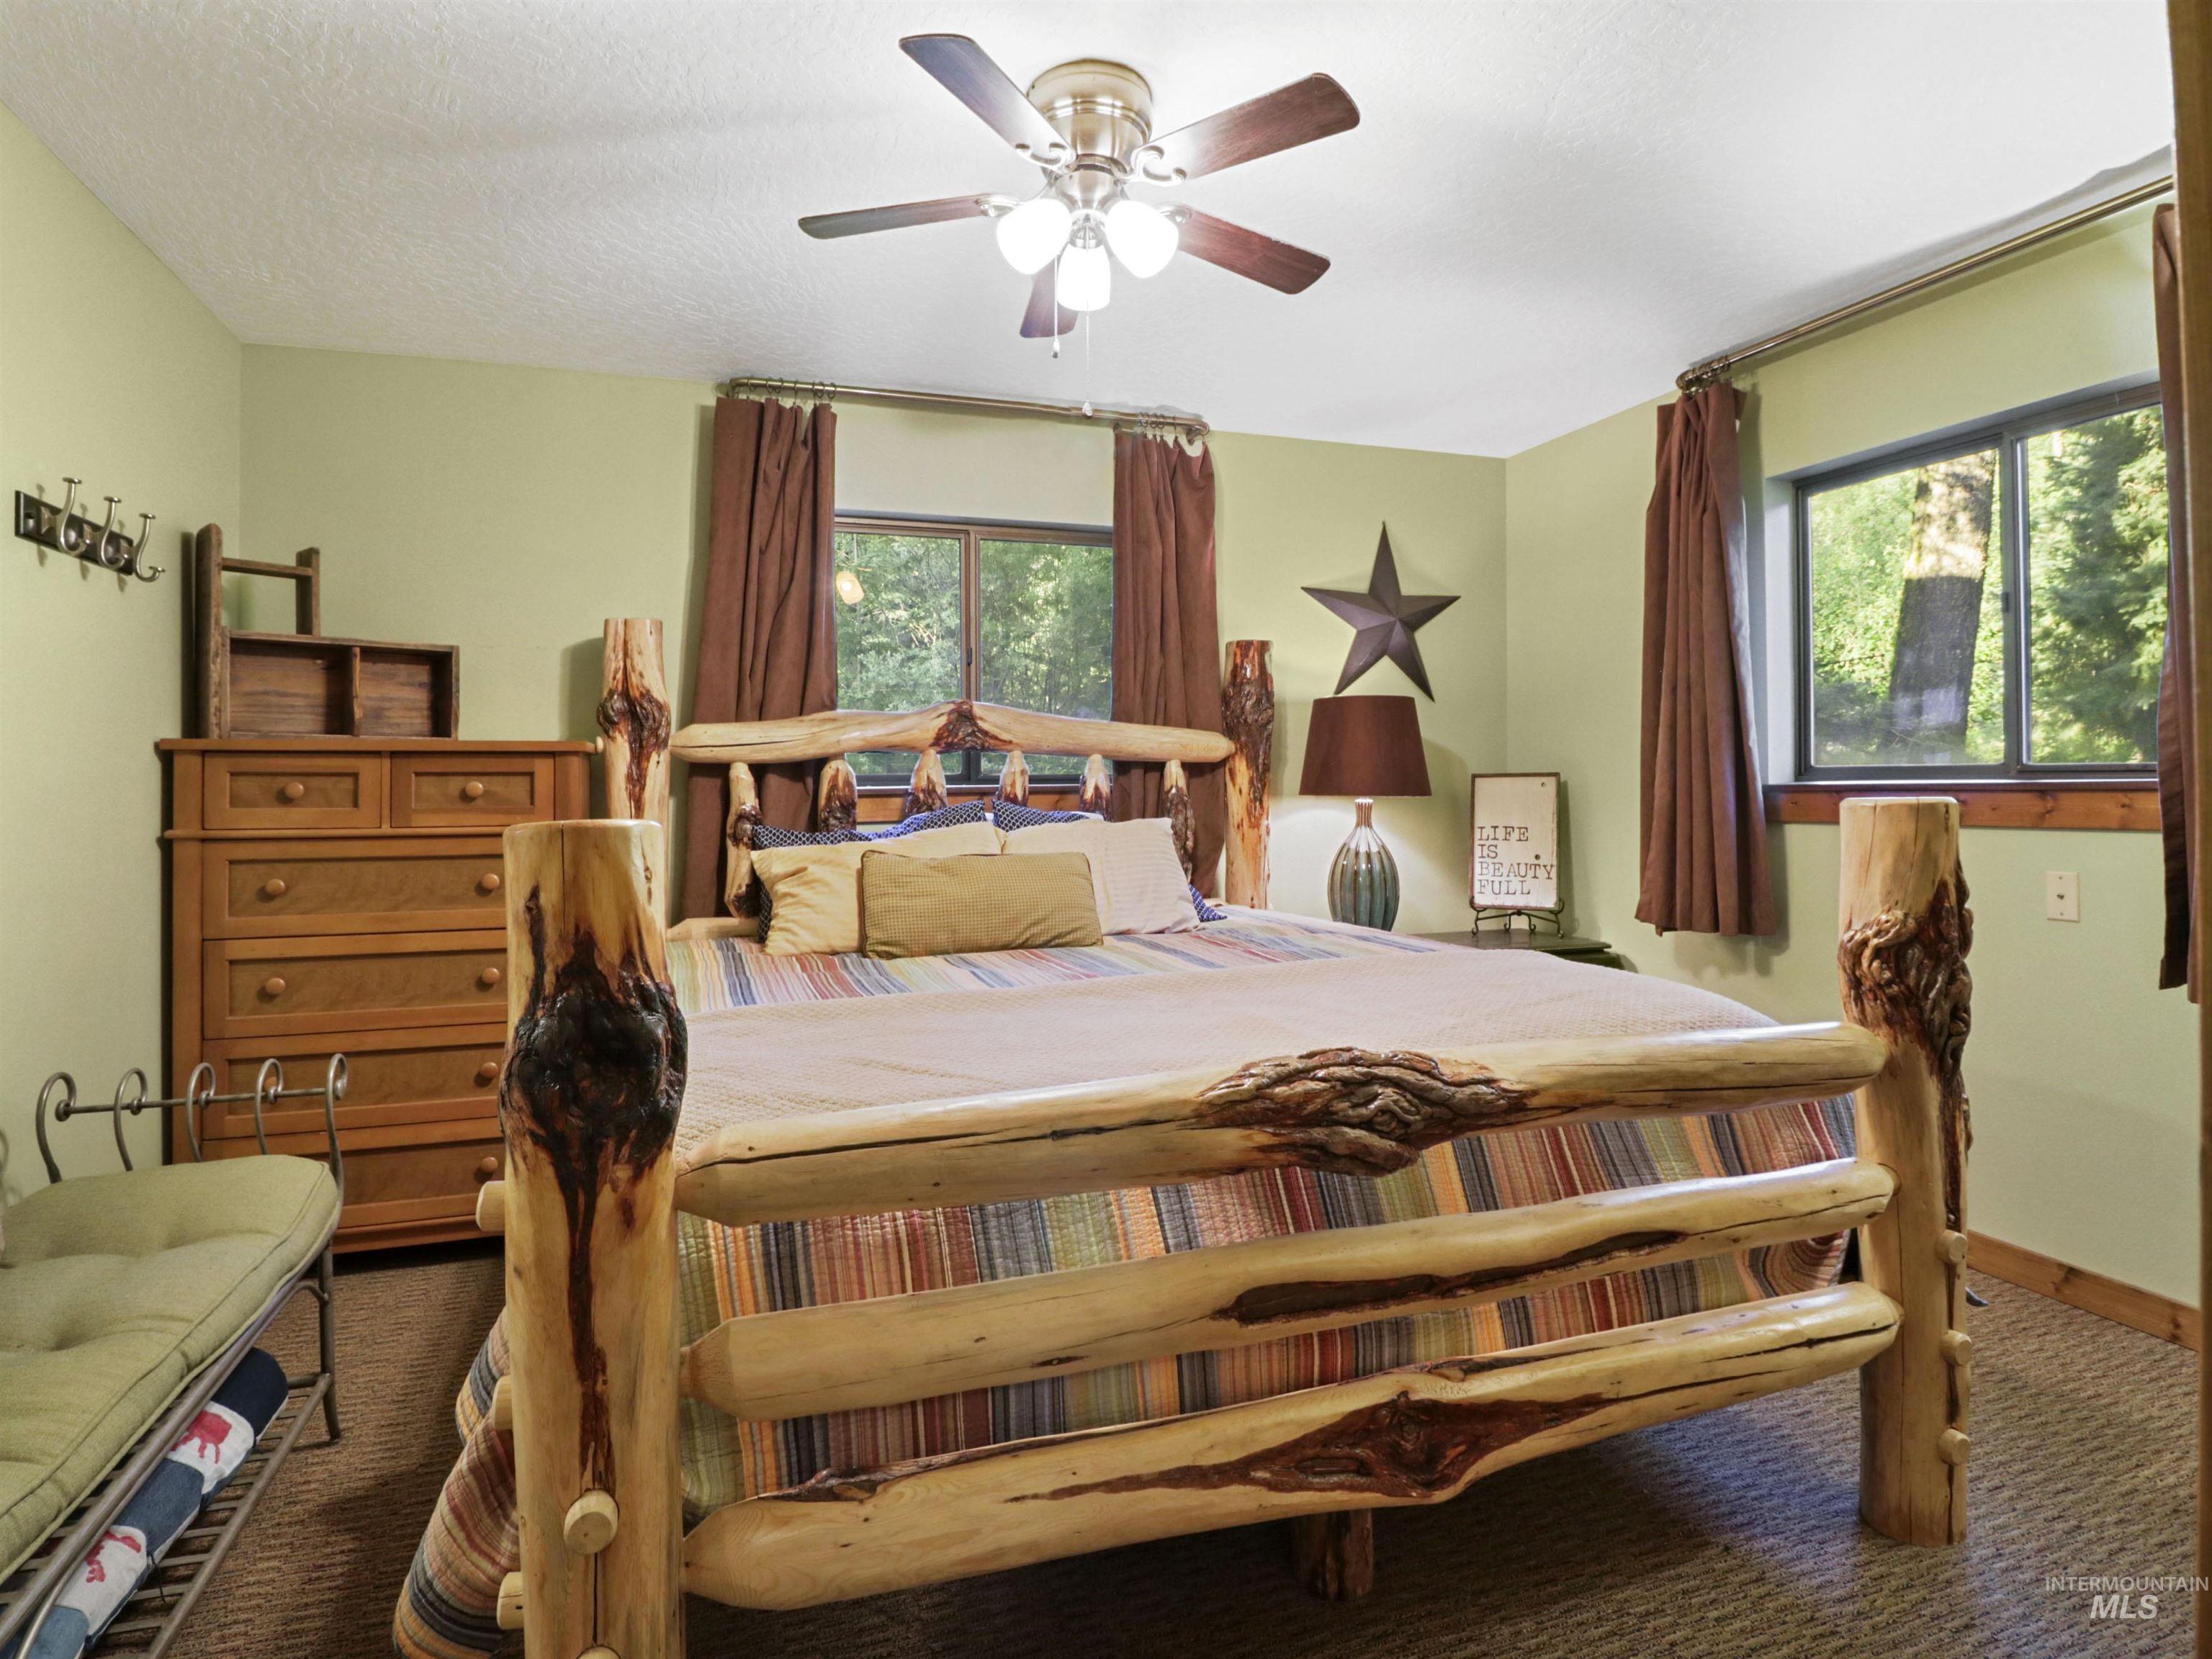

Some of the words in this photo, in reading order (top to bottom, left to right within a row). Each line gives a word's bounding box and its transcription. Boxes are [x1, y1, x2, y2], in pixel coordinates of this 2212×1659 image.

[1477, 826, 1529, 842] LIFE
[1478, 844, 1498, 859] IS
[1478, 861, 1555, 880] BEAUTY
[1477, 879, 1531, 895] FULL
